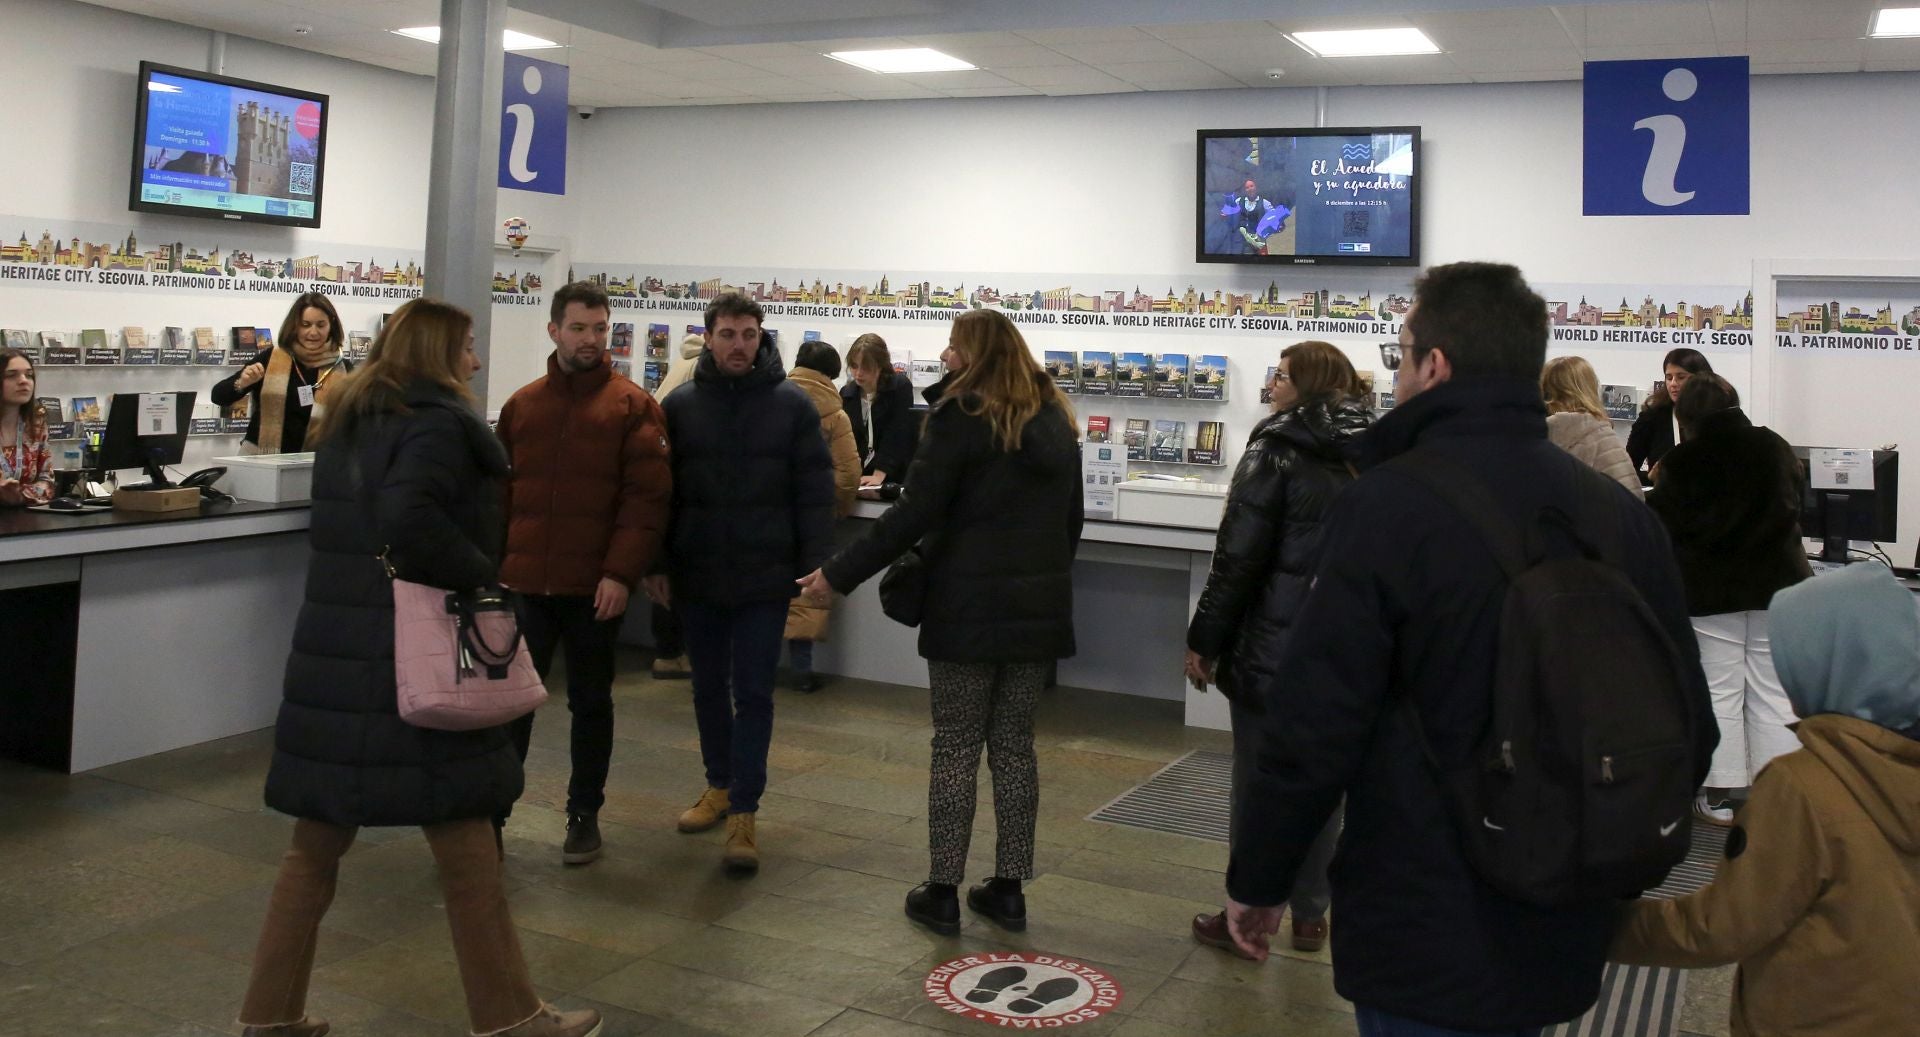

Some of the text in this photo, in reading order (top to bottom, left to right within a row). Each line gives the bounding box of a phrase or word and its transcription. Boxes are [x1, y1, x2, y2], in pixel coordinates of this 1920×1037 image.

[1311, 159, 1329, 176] El
[1313, 176, 1407, 197] y su aguadora
[1, 265, 61, 281] HERITAGE
[65, 270, 93, 283] CITY.
[98, 271, 149, 287] SEGOVIA.
[152, 274, 215, 290] PATRIMONIO
[218, 278, 231, 290] DE
[233, 279, 246, 291] LA
[309, 283, 349, 297] SEGOVIA.
[352, 285, 381, 298] WORLD
[383, 287, 422, 299] HERITAGE
[516, 295, 525, 305] DE
[526, 296, 536, 305] LA
[633, 299, 645, 310] DE
[646, 300, 657, 310] LA
[760, 303, 784, 316] ORLD
[786, 305, 830, 317] HERITAGE
[832, 307, 855, 318] CITY.
[858, 308, 901, 320] SEGOVIA.
[1062, 314, 1109, 326] SEGOVIA.
[1113, 315, 1150, 327] WORLD
[1153, 316, 1206, 329] HERITAGE
[1209, 317, 1237, 330] CITY.
[1241, 318, 1293, 332] SEGOVIA.
[1296, 320, 1368, 334] PATRIMONIO
[1371, 323, 1387, 335] DE
[1553, 328, 1599, 342] WORLD
[1602, 330, 1667, 344] HERITAGE
[1671, 332, 1705, 345] CITY.
[1801, 336, 1889, 350] PATRIMONIO
[1893, 338, 1913, 350] DE
[925, 953, 1118, 1029] MANTENER LA DISTANCIA SOCIAL
